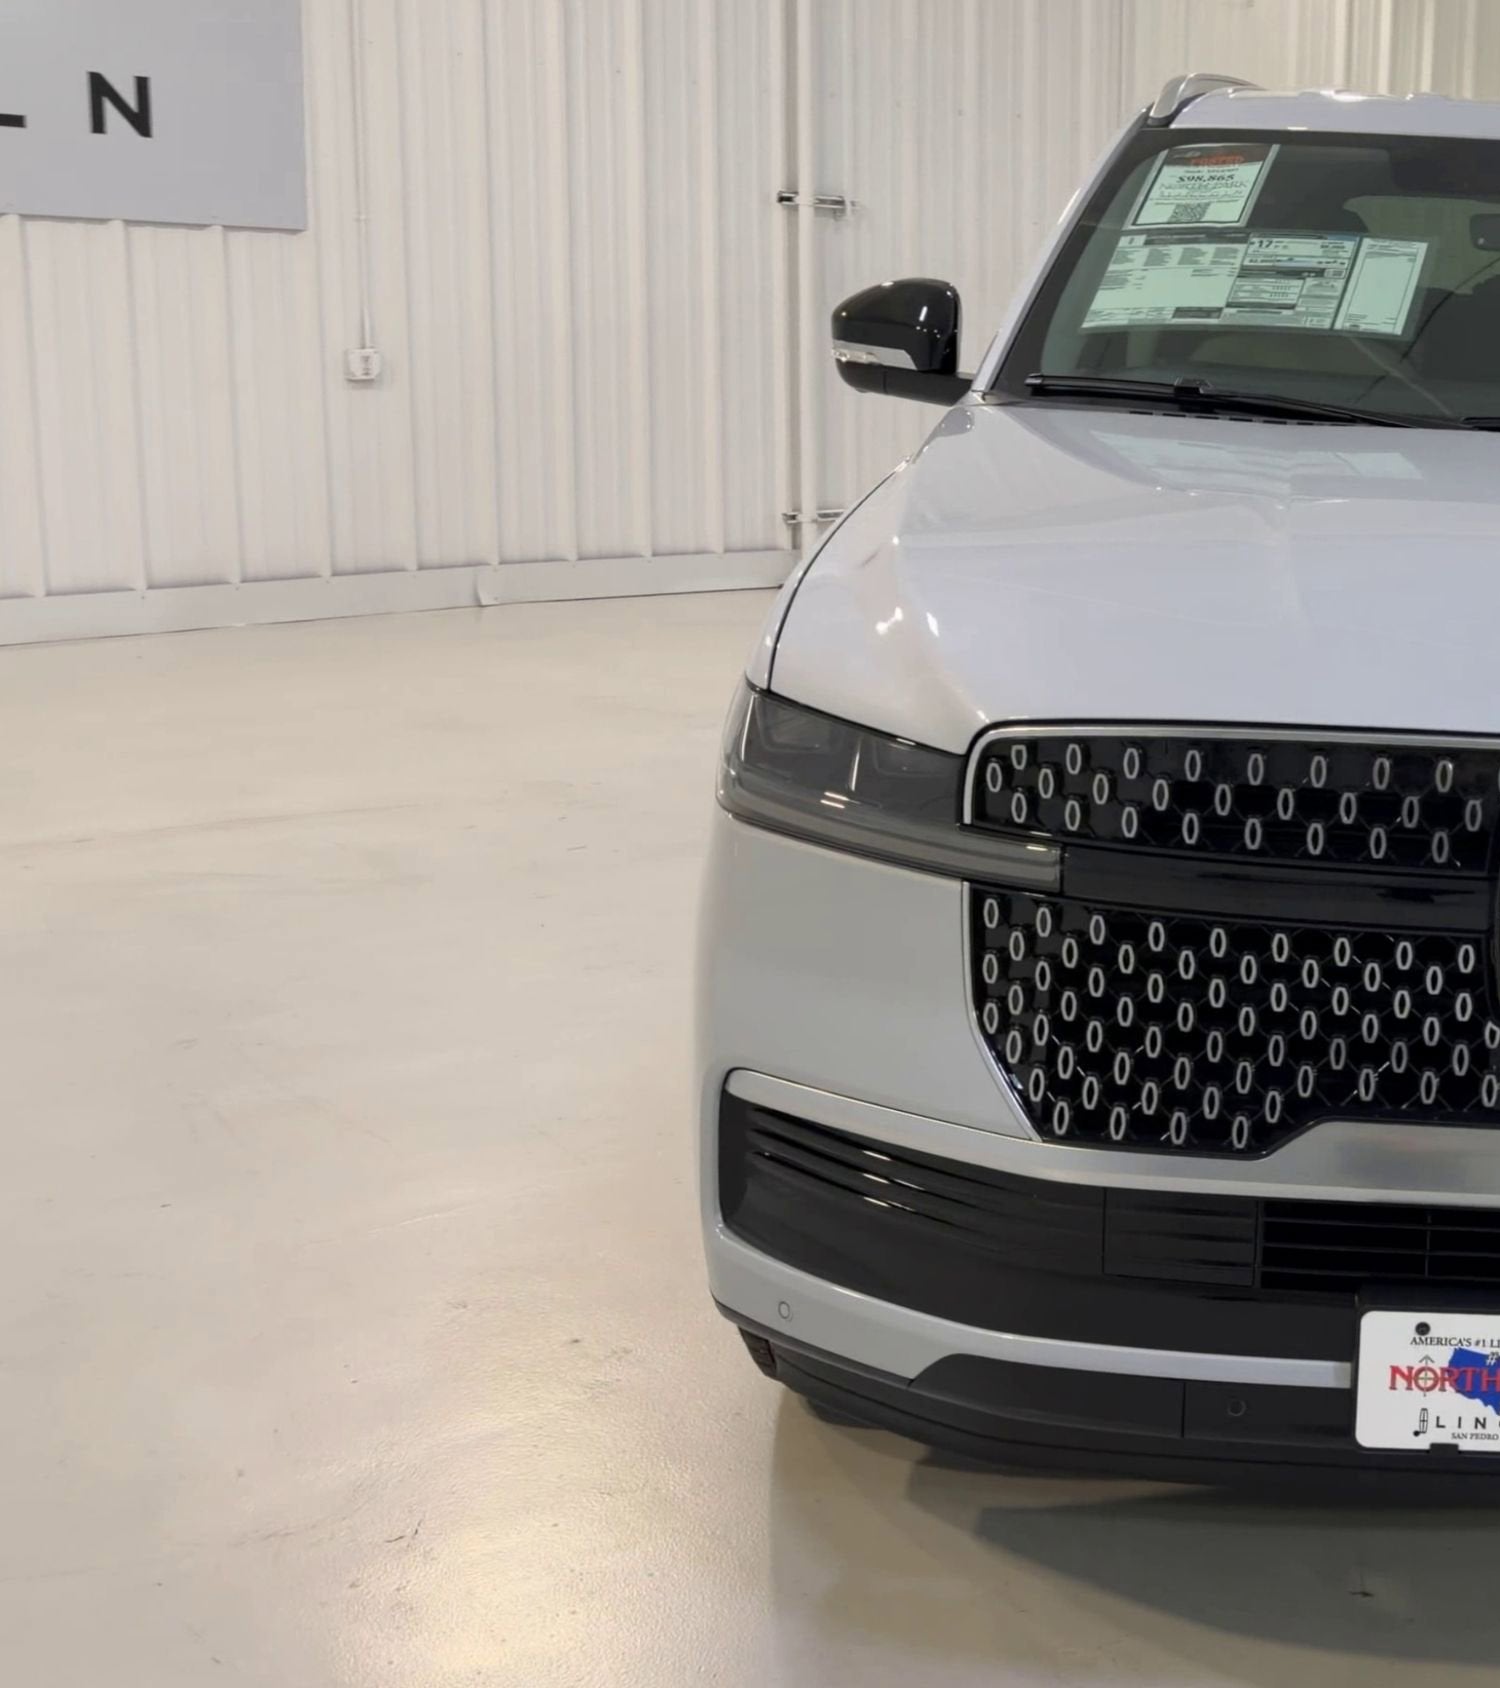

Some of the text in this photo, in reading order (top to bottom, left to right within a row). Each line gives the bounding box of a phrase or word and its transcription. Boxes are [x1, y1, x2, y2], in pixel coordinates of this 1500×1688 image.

[1410, 1335, 1472, 1347] AMERICA'S
[1474, 1337, 1486, 1347] #1
[1451, 1432, 1468, 1440] SAN
[1469, 1433, 1499, 1441] PEDRO
